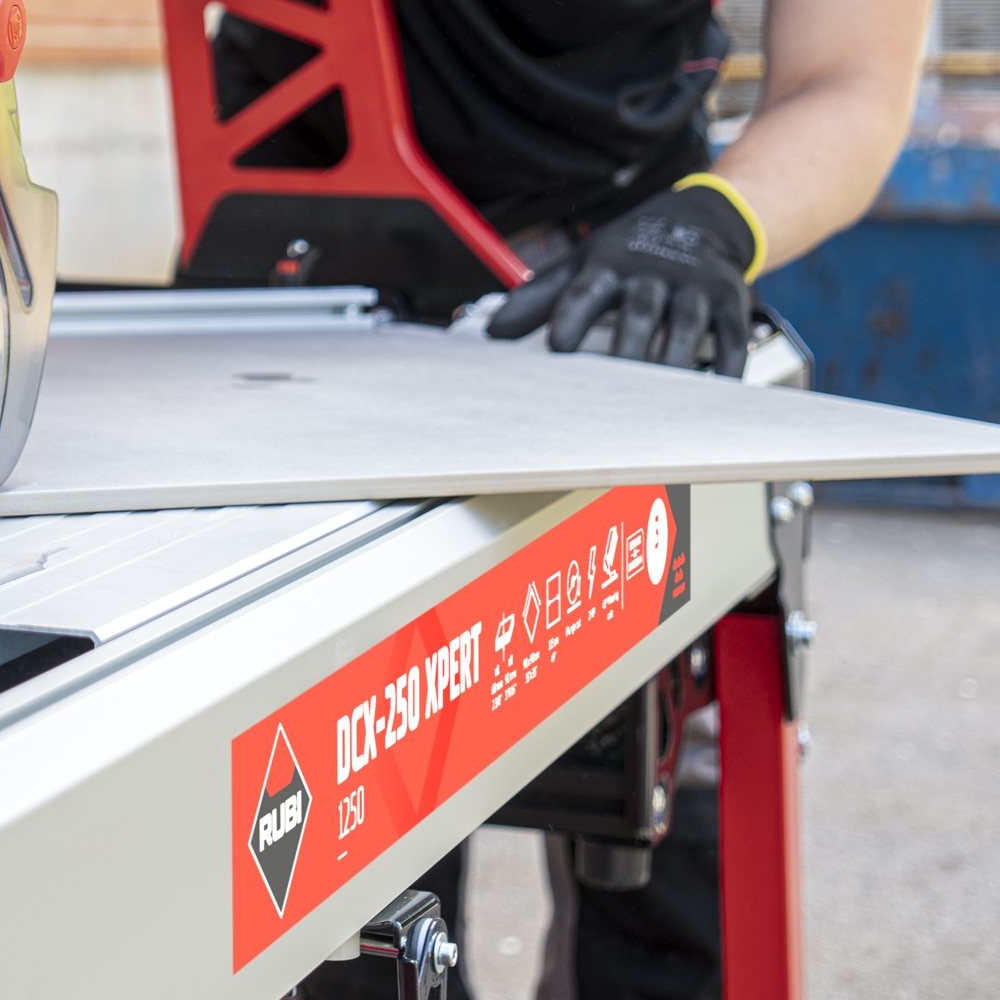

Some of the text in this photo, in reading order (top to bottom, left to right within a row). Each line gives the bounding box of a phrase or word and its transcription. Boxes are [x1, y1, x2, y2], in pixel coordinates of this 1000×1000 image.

[336, 620, 483, 786] DCX-250 XPERT
[259, 789, 303, 853] RUBI
[337, 784, 365, 841] 1250
